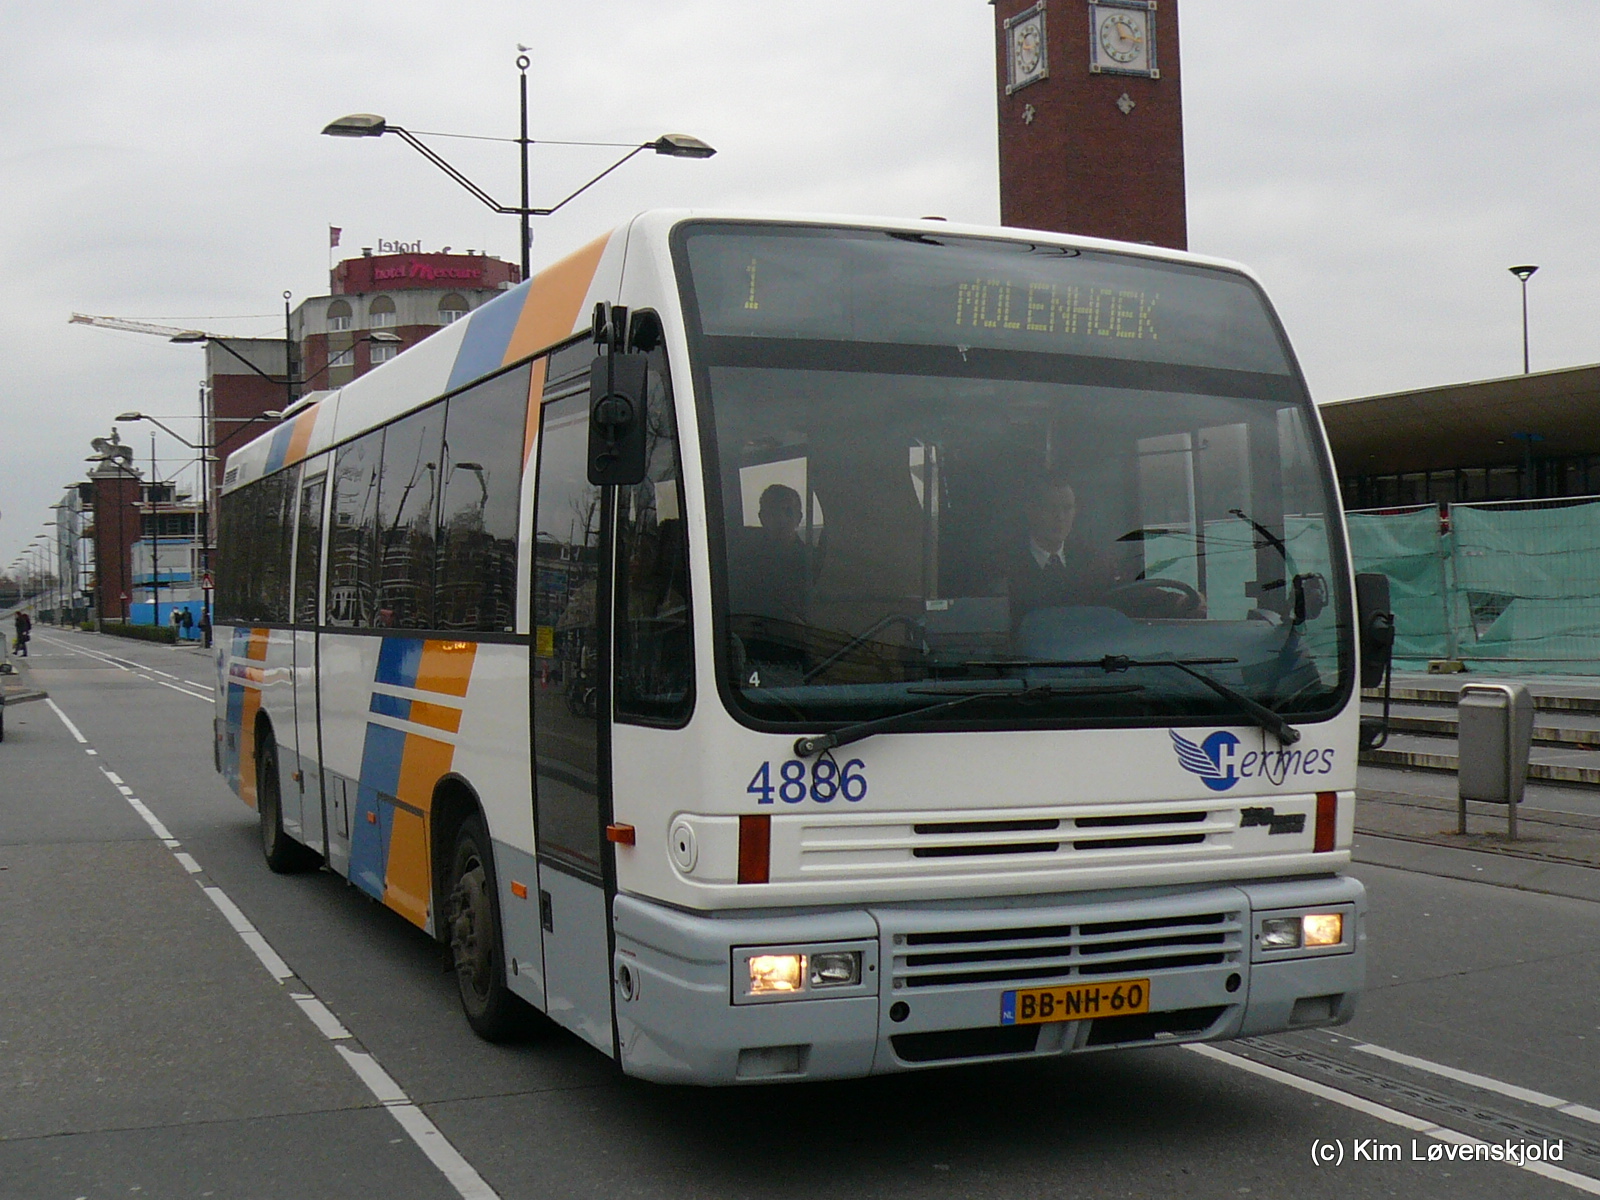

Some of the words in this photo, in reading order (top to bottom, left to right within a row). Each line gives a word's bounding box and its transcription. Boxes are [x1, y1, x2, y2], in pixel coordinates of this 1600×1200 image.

[374, 265, 406, 279] hotel
[409, 259, 480, 280] Mercure
[744, 258, 759, 309] 1
[955, 278, 1160, 340] MOLENHOEK
[748, 671, 760, 687] 4
[1203, 734, 1335, 786] Hermes
[746, 758, 868, 805] 4886
[1003, 1010, 1014, 1019] NL
[1021, 984, 1143, 1019] BB-NH-60
